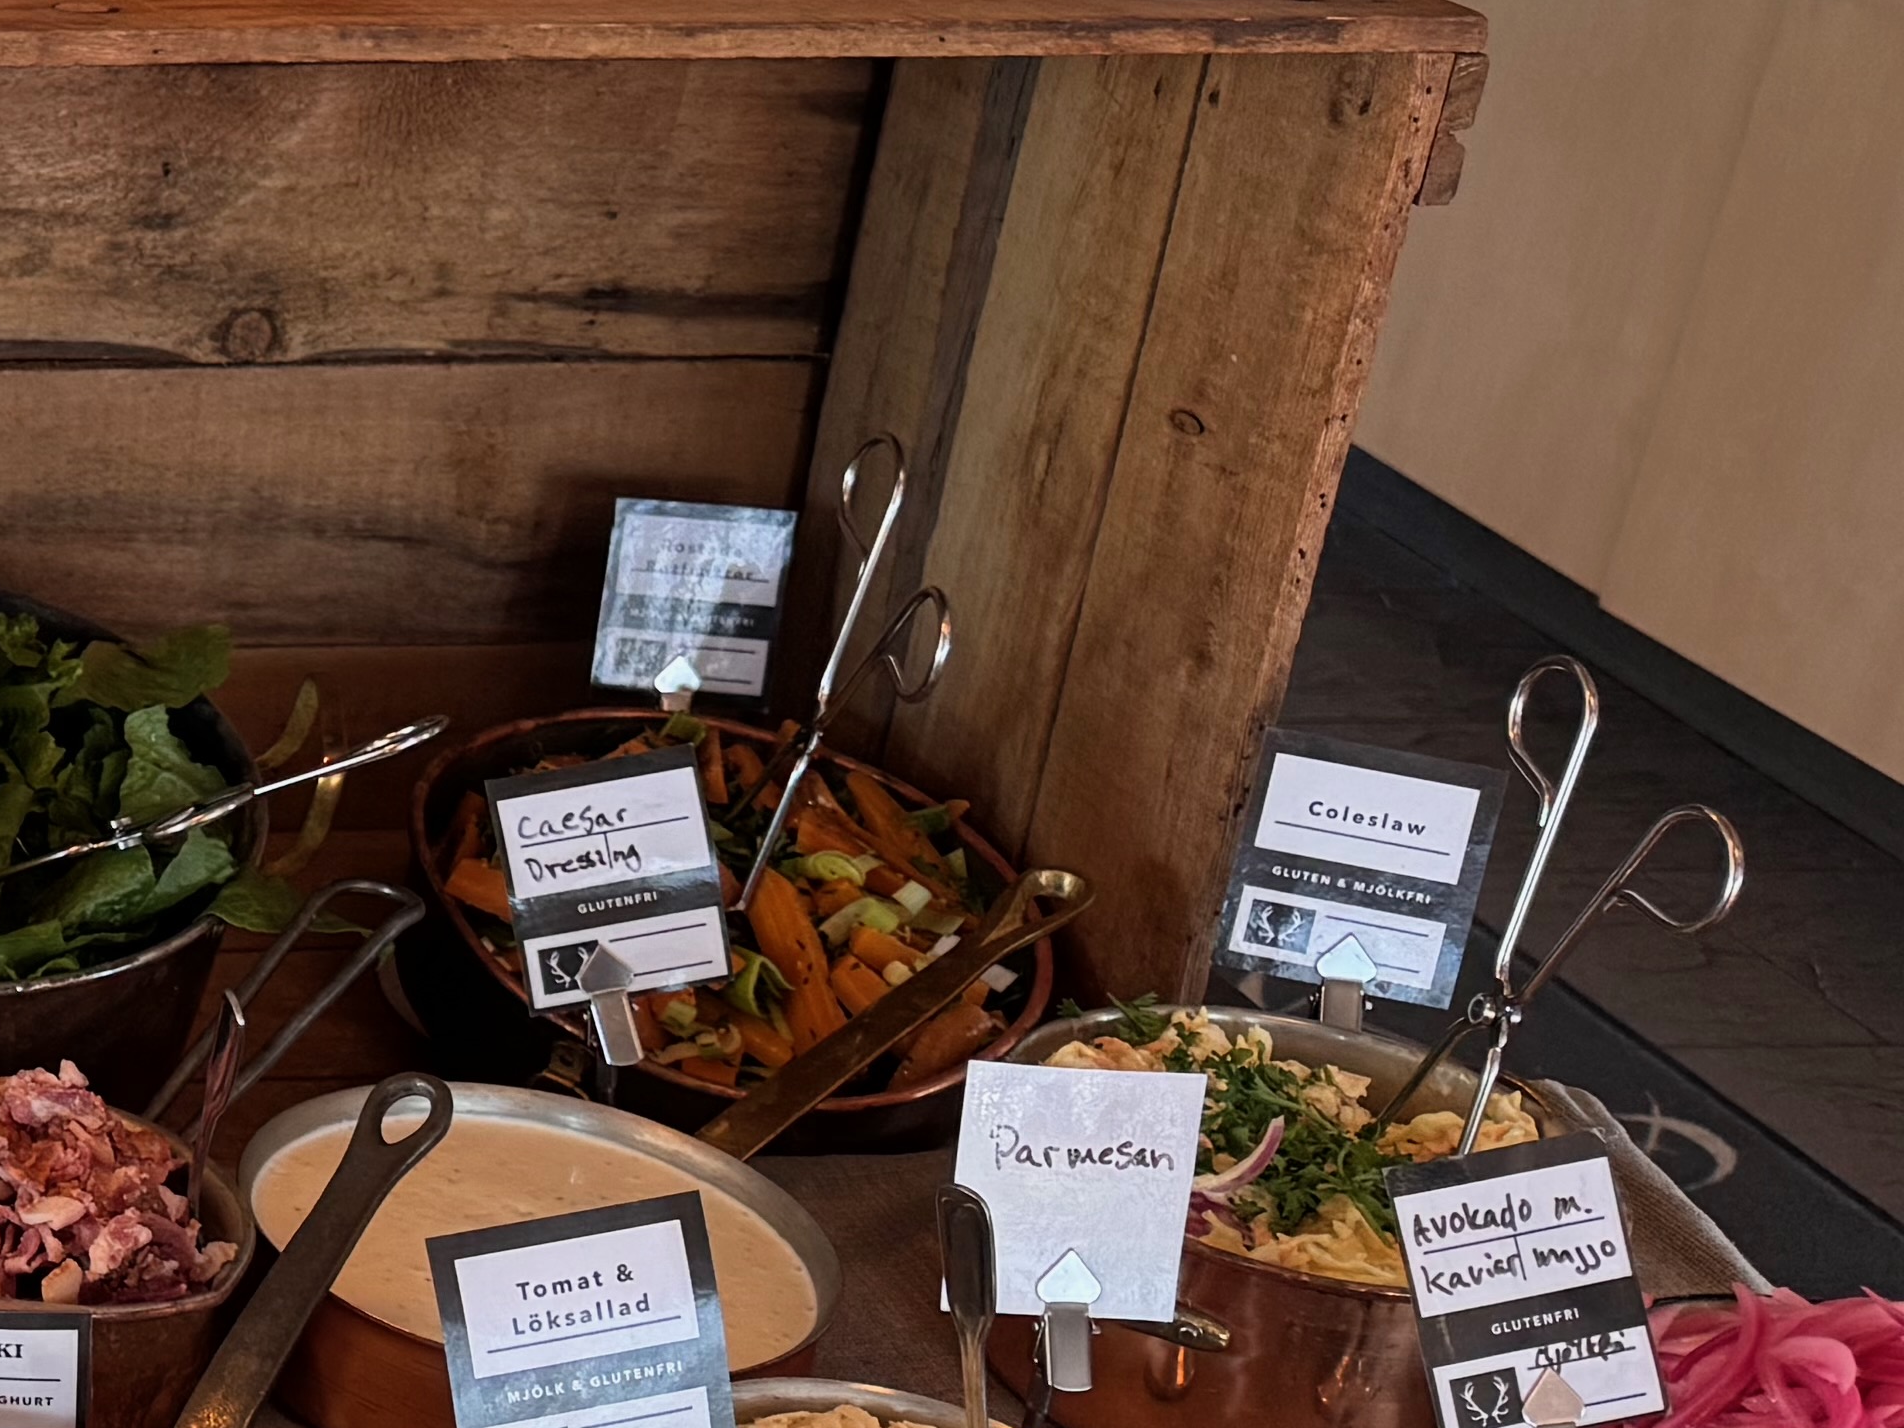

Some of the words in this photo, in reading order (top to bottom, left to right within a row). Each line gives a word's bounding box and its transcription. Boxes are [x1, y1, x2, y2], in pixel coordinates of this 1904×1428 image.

[517, 805, 628, 840] Caesar
[1308, 801, 1426, 836] Coleslaw
[524, 843, 641, 882] Dressing
[577, 891, 658, 914] GLUTENFRI
[1272, 865, 1330, 886] GLUTEN
[1354, 880, 1431, 905] MJÖLKFRI
[989, 1125, 1174, 1171] Parmesan
[1413, 1193, 1532, 1246] Avokado
[516, 1270, 604, 1300] Tomat
[616, 1263, 634, 1283] &
[512, 1293, 651, 1335] Löksallad
[1491, 1307, 1580, 1335] GLUTENFRI
[507, 1382, 565, 1404] MJÖLK
[589, 1360, 682, 1388] GLUTENFRI
